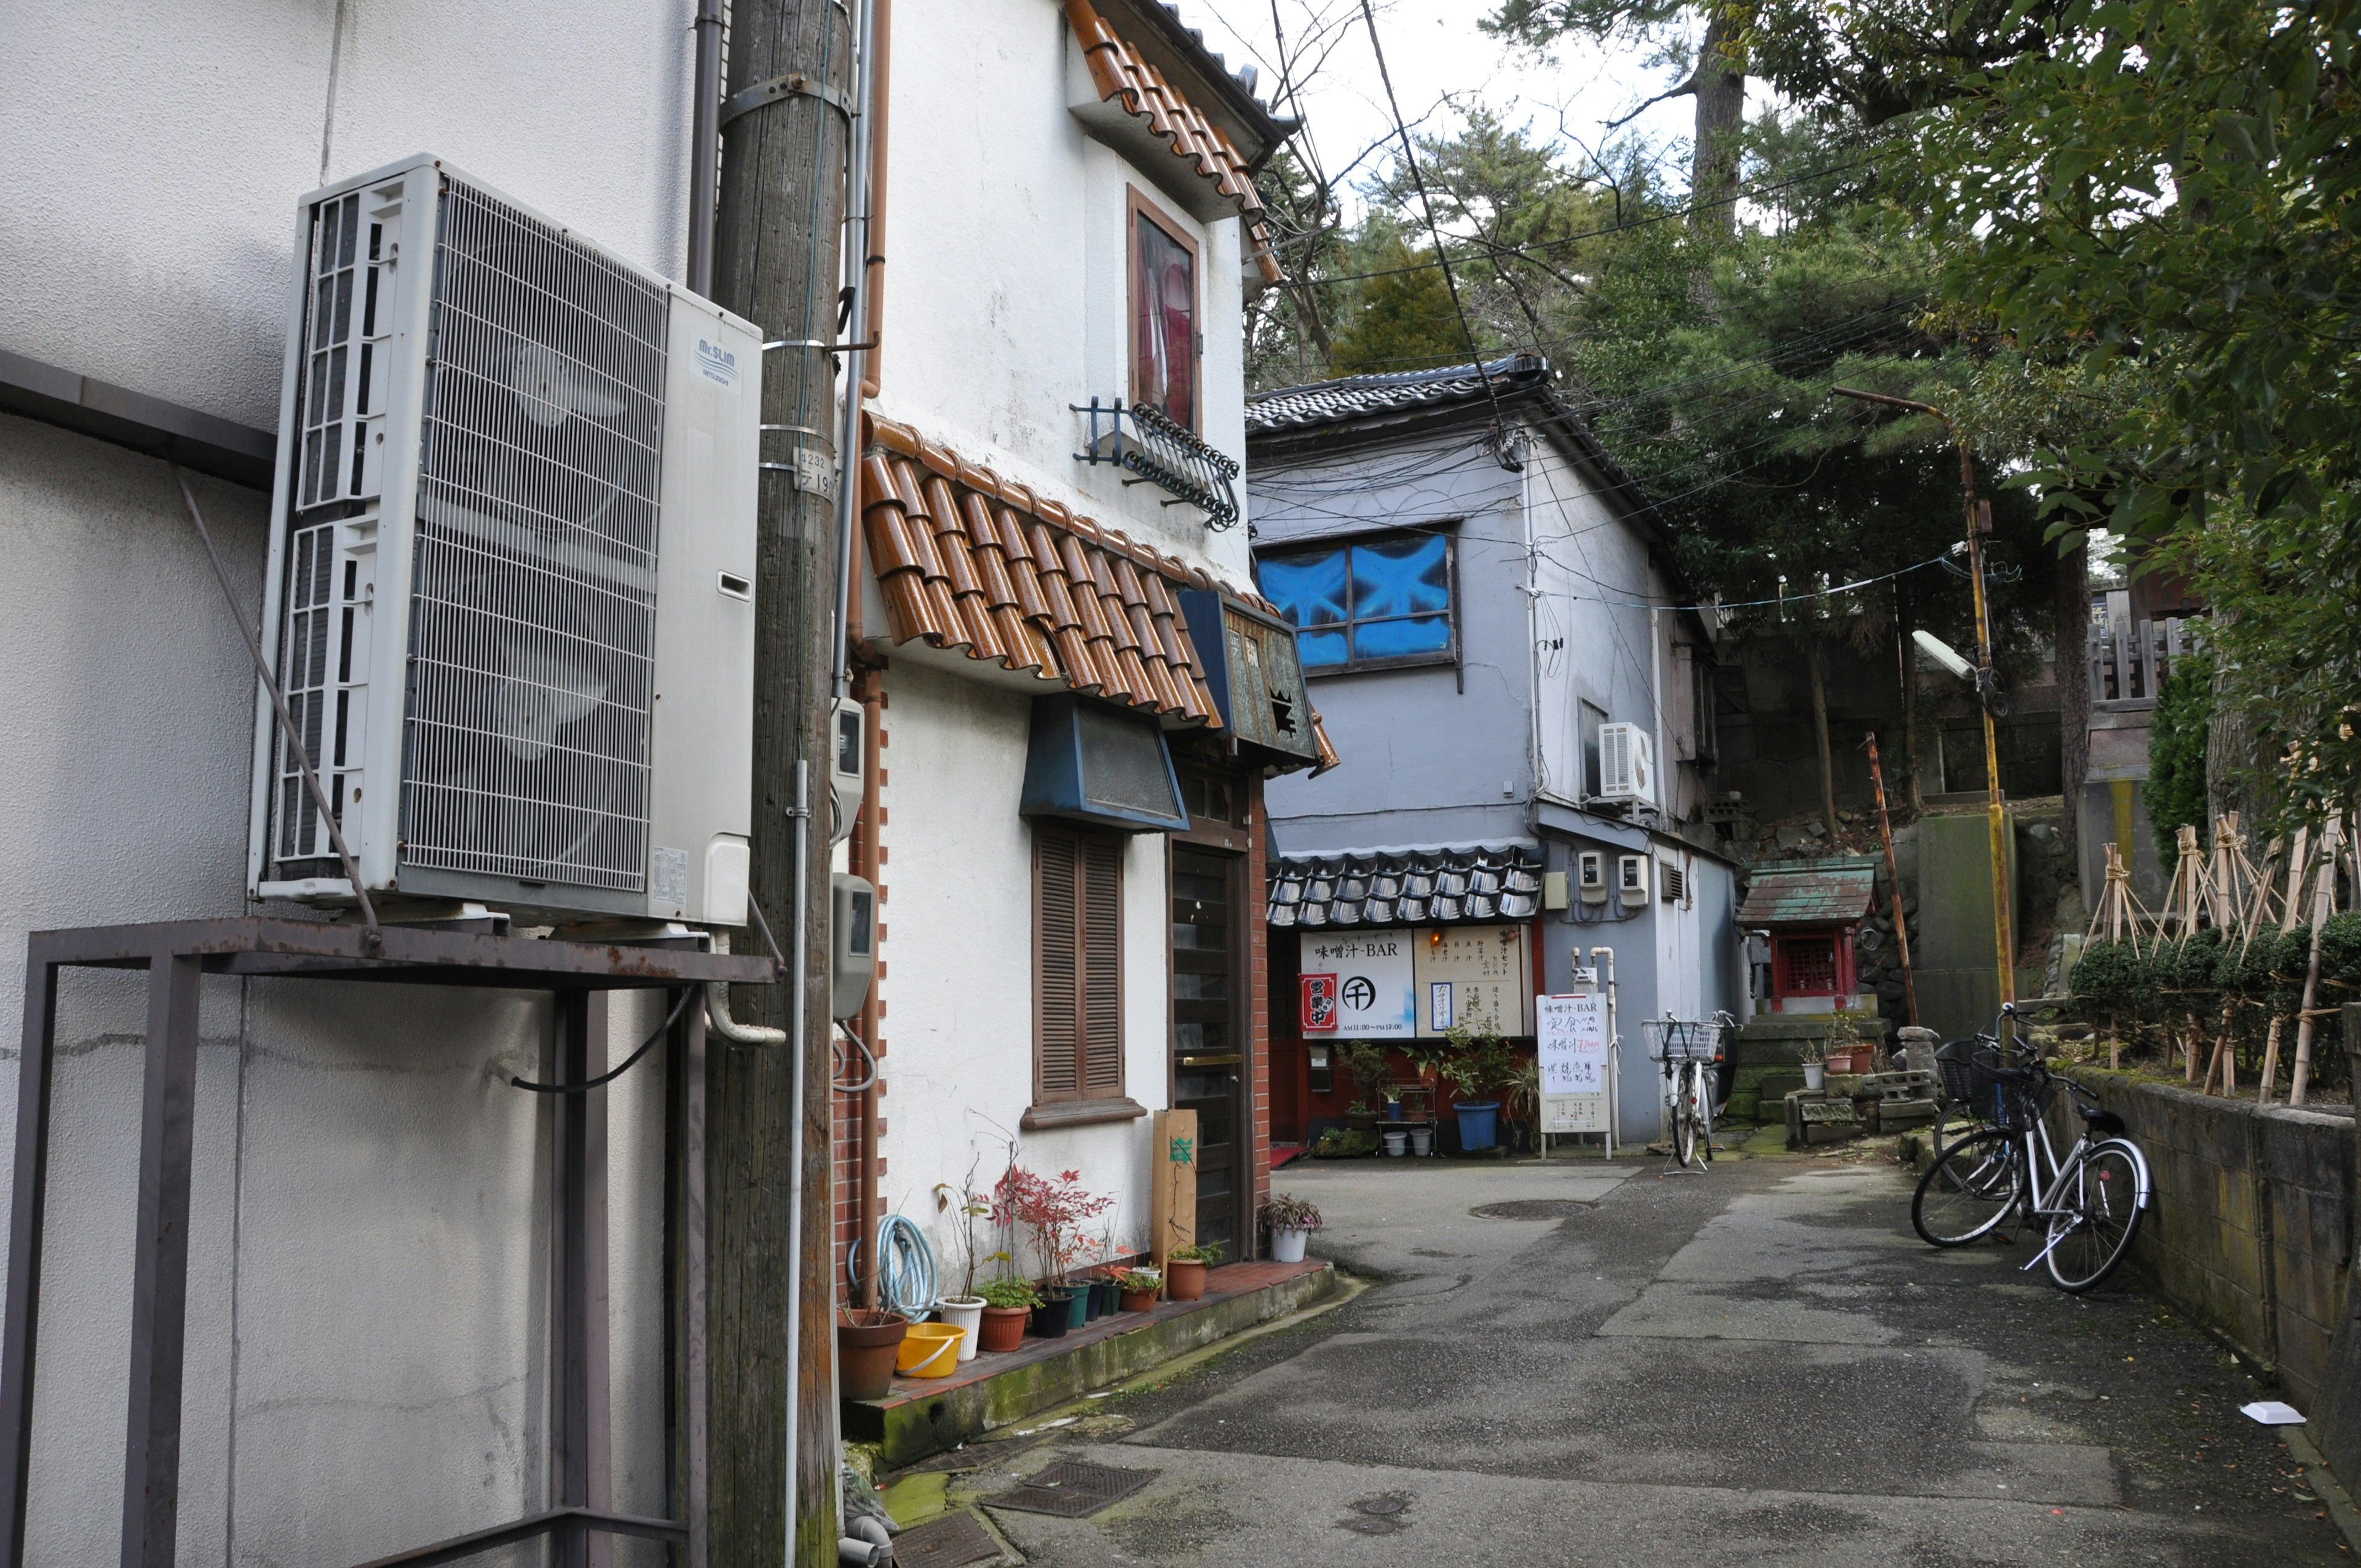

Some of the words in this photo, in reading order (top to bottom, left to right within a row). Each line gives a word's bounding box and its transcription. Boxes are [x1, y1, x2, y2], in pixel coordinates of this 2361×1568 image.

[699, 339, 735, 367] Mr.SLIM
[703, 369, 729, 386] MITSUBISHI
[1310, 980, 1325, 1025] 営業中
